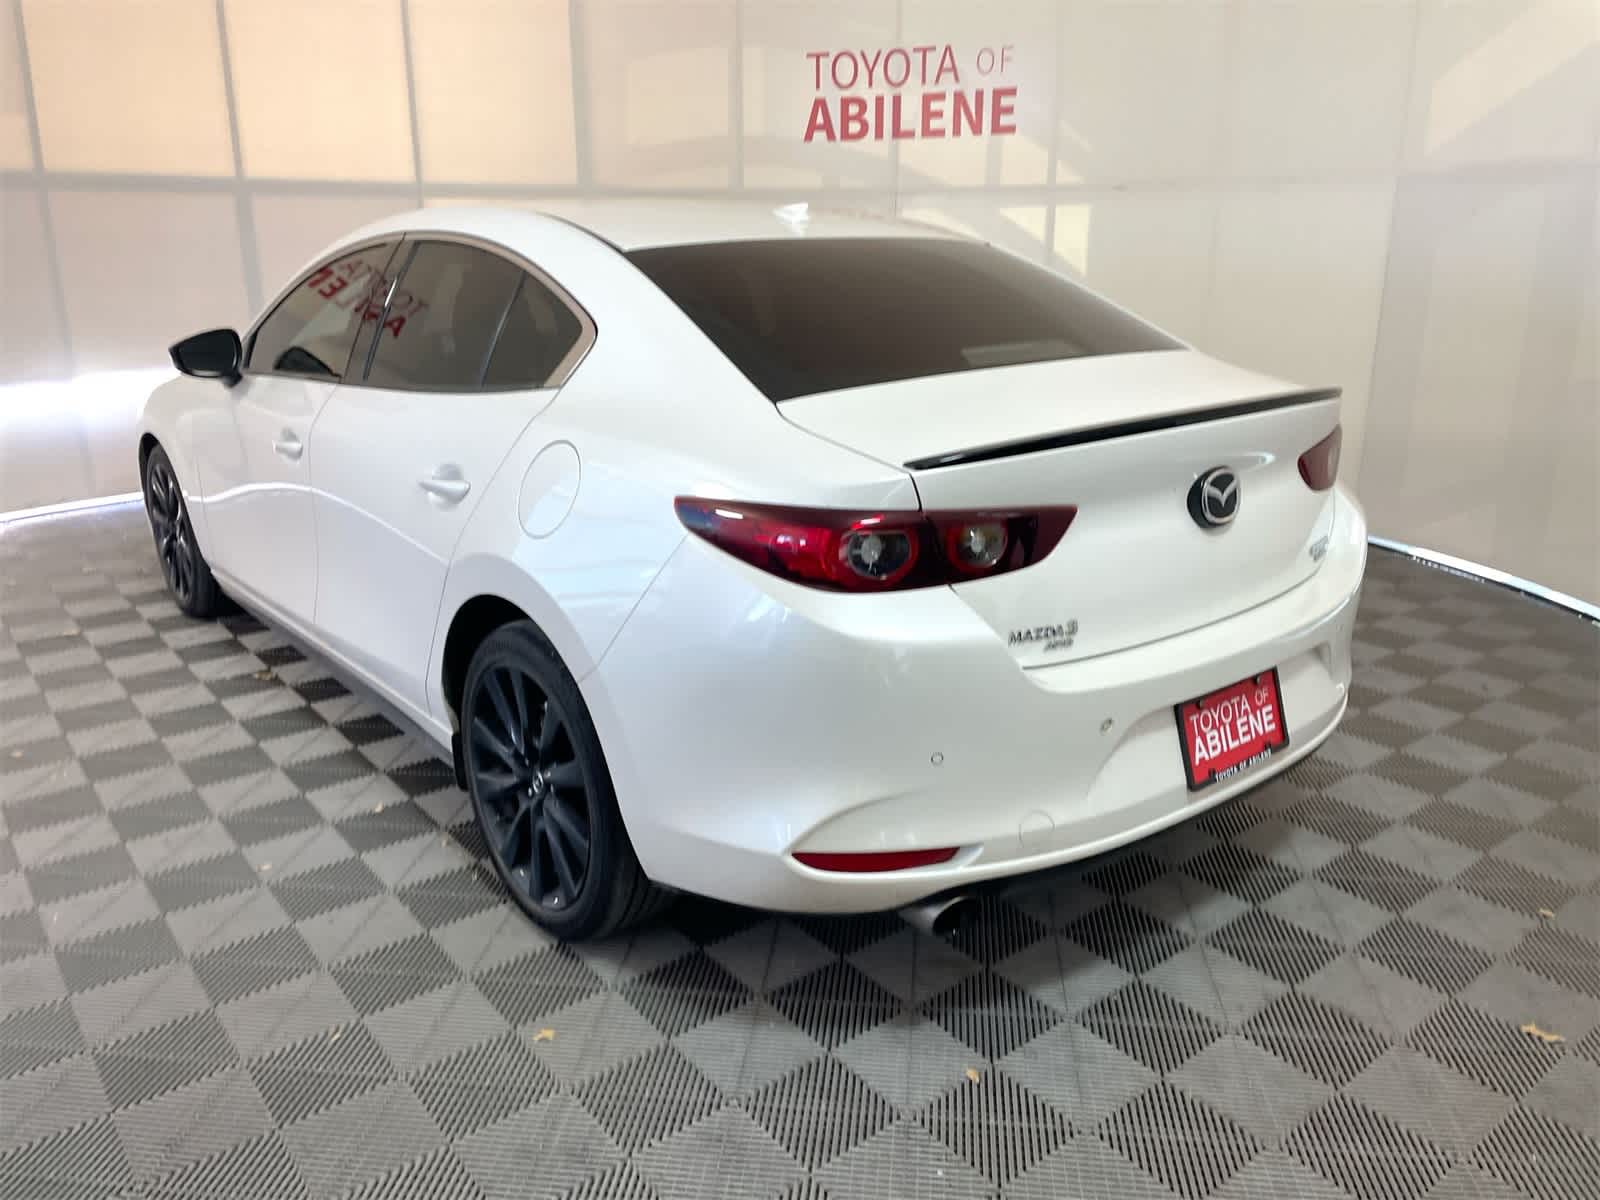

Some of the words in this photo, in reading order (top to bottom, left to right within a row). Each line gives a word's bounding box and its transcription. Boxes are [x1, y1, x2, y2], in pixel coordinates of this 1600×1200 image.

[805, 44, 960, 91] TOYOTA
[975, 44, 1015, 77] OF
[803, 86, 1018, 143] ABILENE
[1189, 693, 1252, 737] TOYOTA
[1254, 687, 1269, 706] OF
[1194, 703, 1277, 767] ABILENE
[1215, 764, 1238, 783] TOYOTA
[1239, 759, 1247, 770] OF
